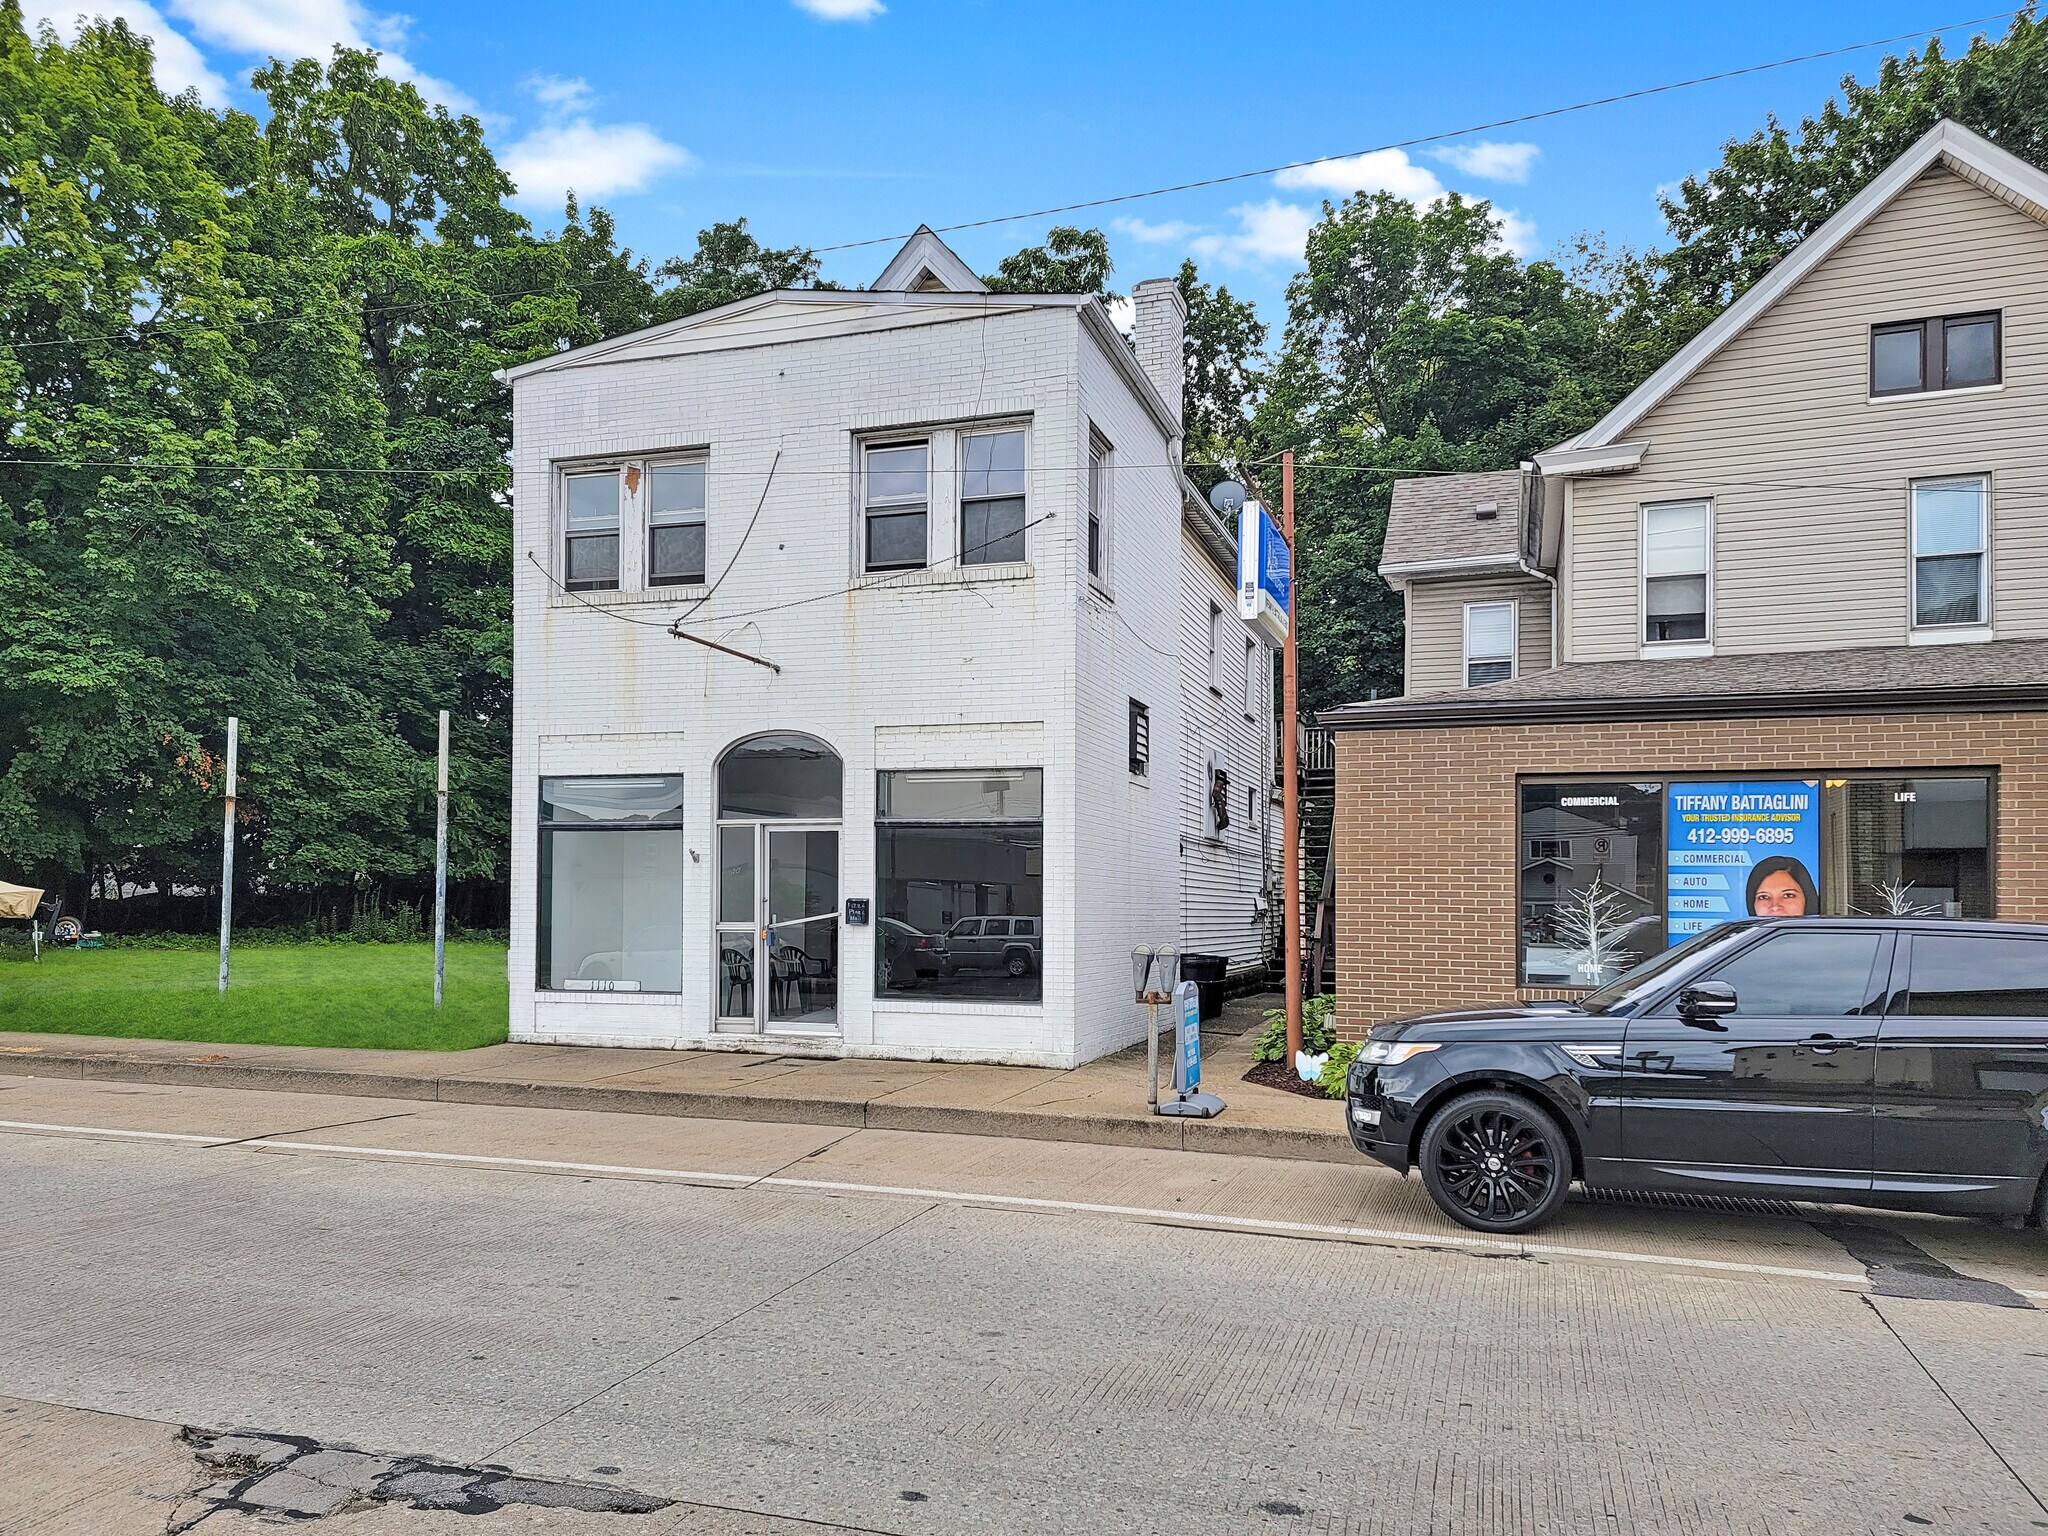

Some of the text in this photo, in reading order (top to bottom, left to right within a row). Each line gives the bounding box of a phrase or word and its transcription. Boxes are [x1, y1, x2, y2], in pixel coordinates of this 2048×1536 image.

[1561, 796, 1619, 807] COMMERCIAL
[1894, 792, 1916, 802] LIFE
[1675, 794, 1809, 811] TIFFANY BATTAGLINI
[1682, 813, 1801, 823] YOUR TRUSTED INSURANCE ADVISOR
[1687, 827, 1795, 844] 412-999-6895
[1683, 854, 1746, 864] COMMERCIAL
[1683, 877, 1708, 886] AUTO
[1683, 899, 1710, 909] HOME
[1683, 921, 1703, 931] LIFE
[1577, 963, 1603, 974] HOME
[591, 980, 615, 991] 1110
